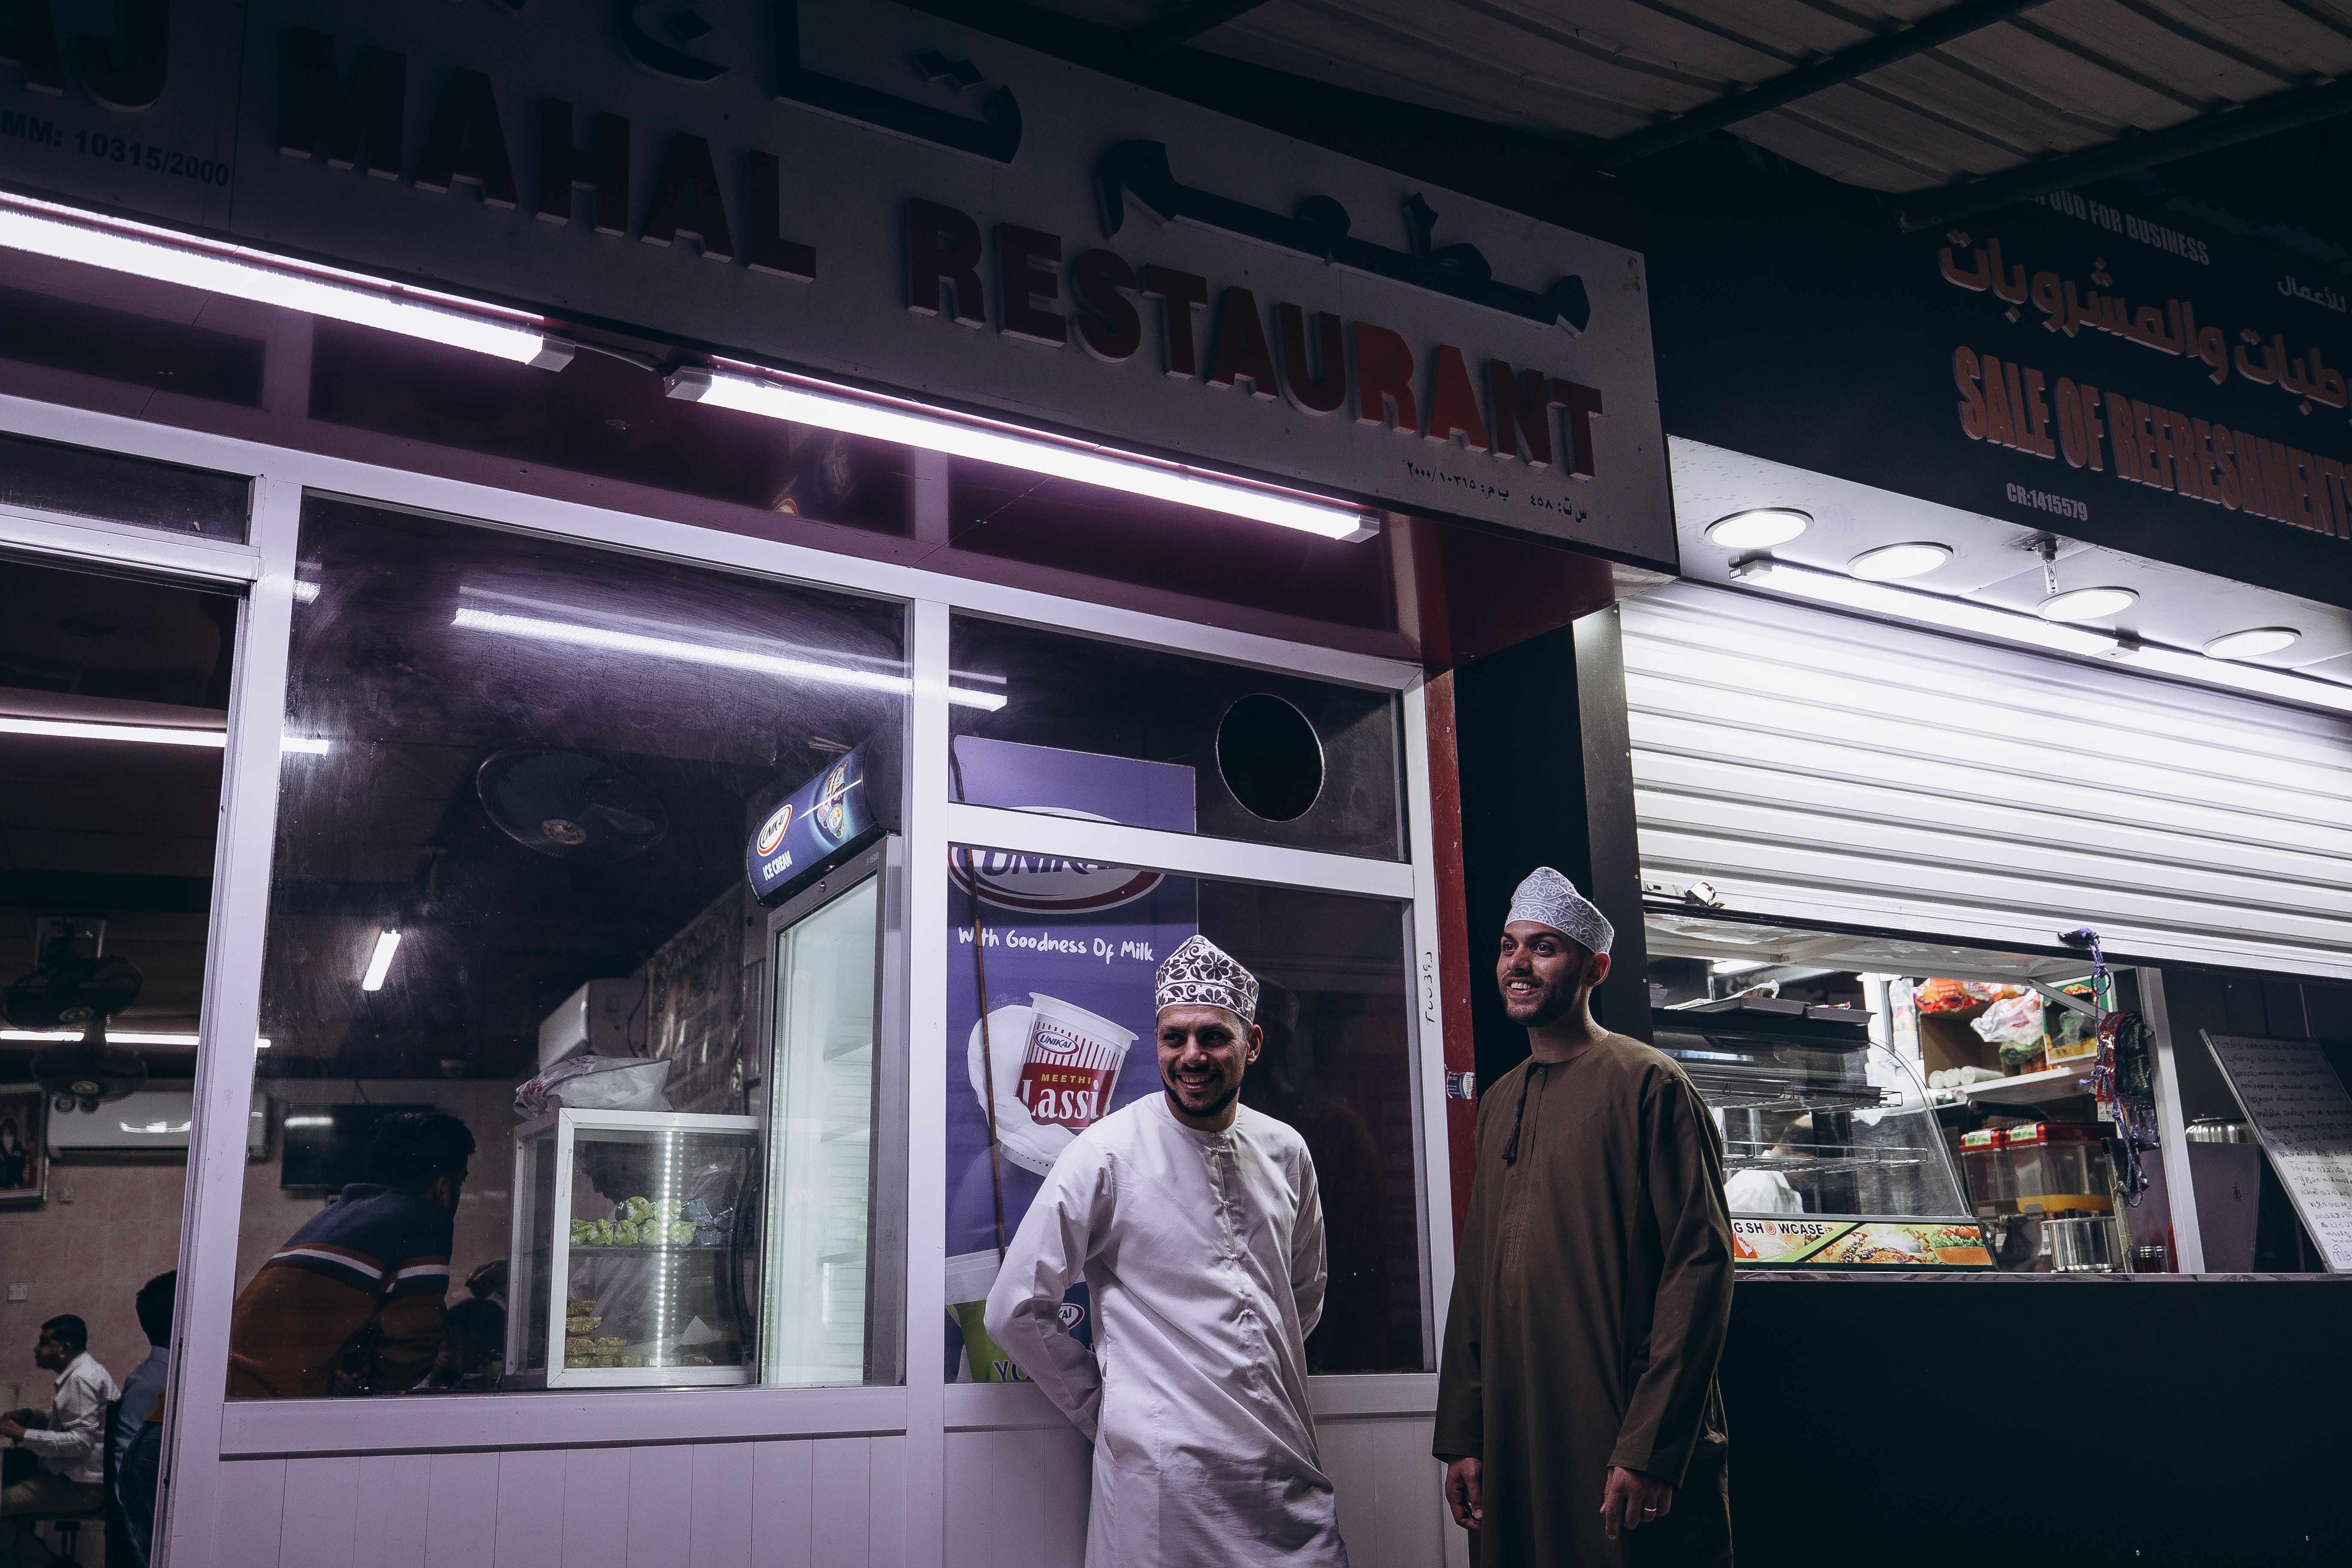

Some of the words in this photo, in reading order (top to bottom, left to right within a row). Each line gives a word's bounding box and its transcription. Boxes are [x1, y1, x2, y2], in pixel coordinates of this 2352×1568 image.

[74, 129, 229, 187] 10315/2000
[279, 23, 816, 284] MAHAL
[907, 196, 1603, 480] RESTAURANT
[2089, 199, 2123, 235] FOR
[2125, 213, 2210, 266] BUSINESS
[1937, 227, 2229, 385] والمشروبات
[1952, 345, 2056, 459] SALE
[2053, 377, 2104, 472] OF
[2006, 482, 2088, 522] CR:1415579
[762, 862, 775, 881] ICE
[772, 850, 793, 875] CREAM
[959, 926, 1000, 946] Wth
[1006, 929, 1087, 954] Goodness
[1093, 937, 1114, 965] Of
[1121, 941, 1154, 962] Milk
[1039, 1034, 1072, 1049] UNIKAI
[1041, 1073, 1091, 1084] MEETHI
